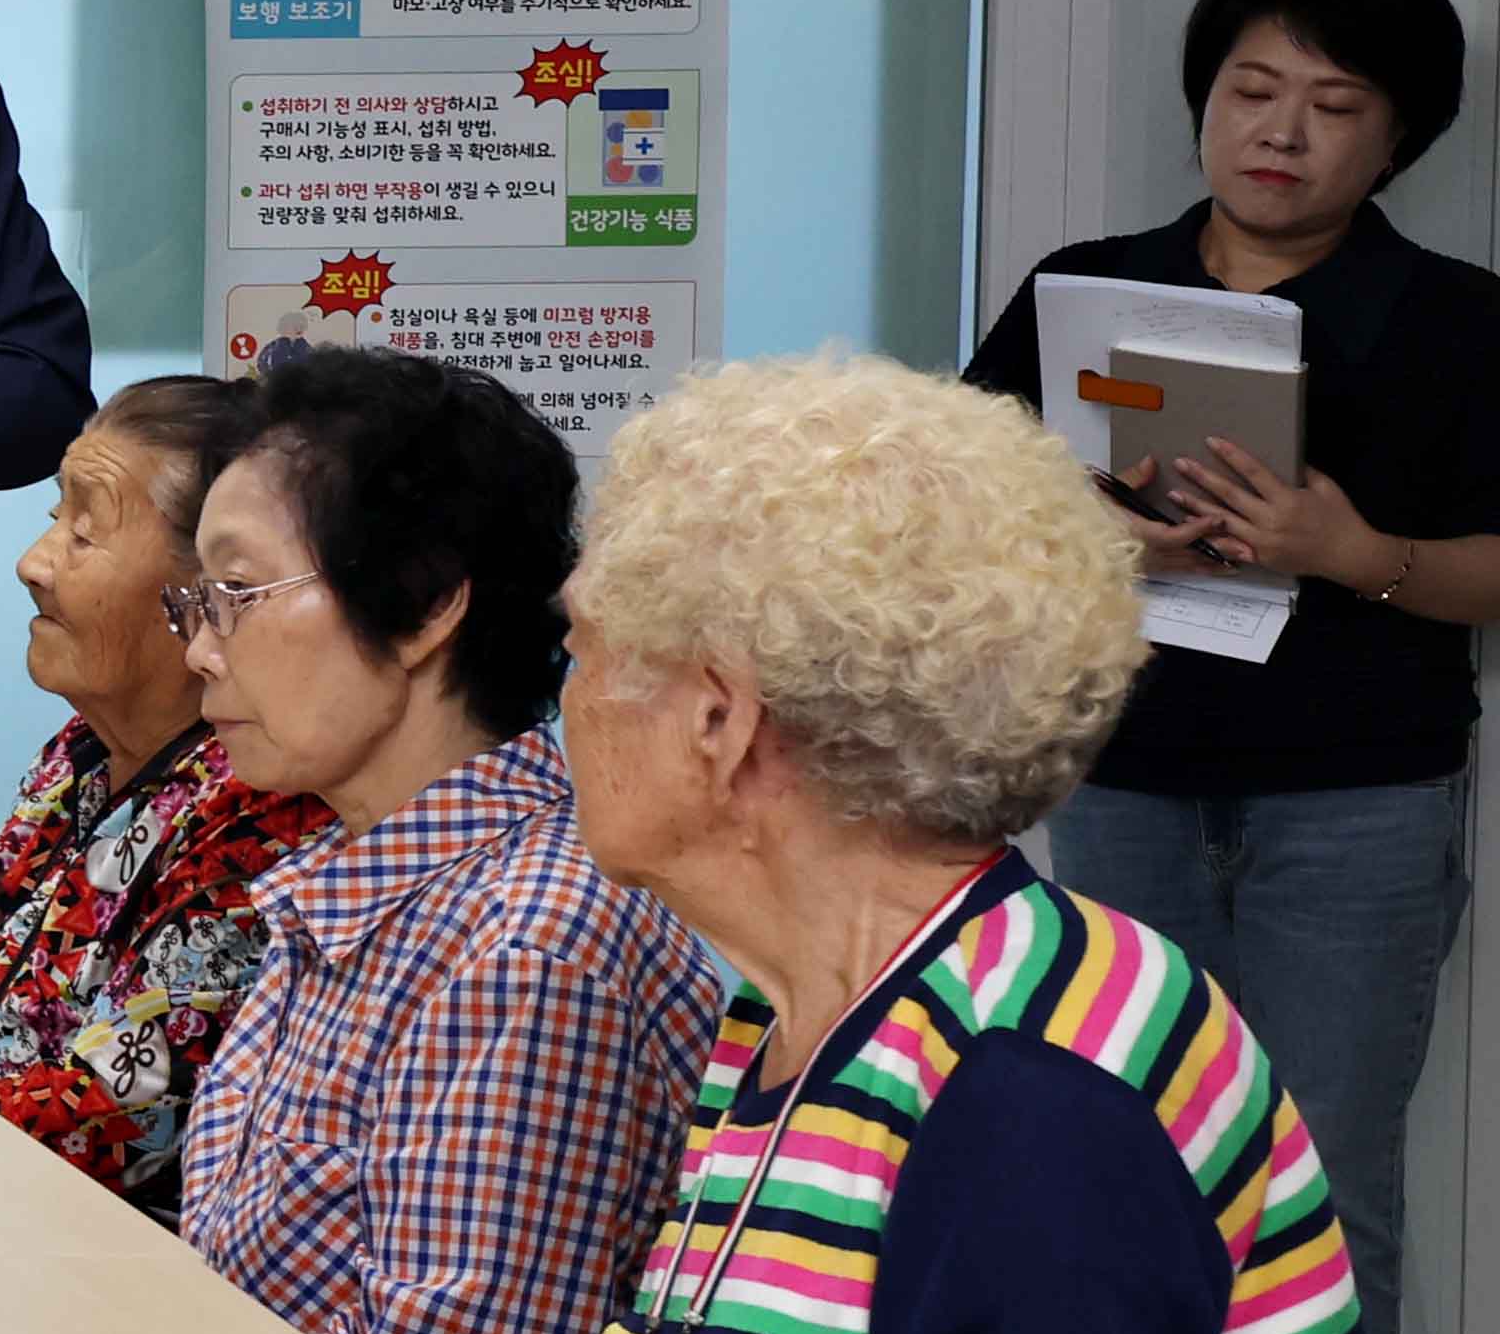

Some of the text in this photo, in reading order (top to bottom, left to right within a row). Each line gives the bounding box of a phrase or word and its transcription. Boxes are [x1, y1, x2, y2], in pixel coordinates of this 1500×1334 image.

[238, 0, 352, 24] 보행 보조기
[533, 58, 593, 88] 조심!
[260, 96, 499, 116] 섭취하기 전 의사와 상담하시고
[259, 119, 497, 138] 구매시 기능성 표시, 섭취 방법,
[259, 142, 556, 163] 주의 사항, 소비기한 등을 꼭 확인하세요.
[258, 180, 555, 200] 과다 섭취 하면 부작용이 생길 수 있으니
[257, 205, 463, 225] 권량장을 맞춰 섭취하세요.
[570, 208, 694, 232] 건강기능 식품
[322, 270, 380, 299] 조심!
[389, 307, 651, 327] 침실이나 욕실 등에 미끄럼 방지용
[388, 330, 656, 350] 제품을, 침대 주변에 안전 손잡이를
[443, 354, 513, 372] 안전하게
[518, 354, 552, 372] 눕고
[559, 353, 650, 372] 일어나세요.
[539, 392, 575, 408] 의해
